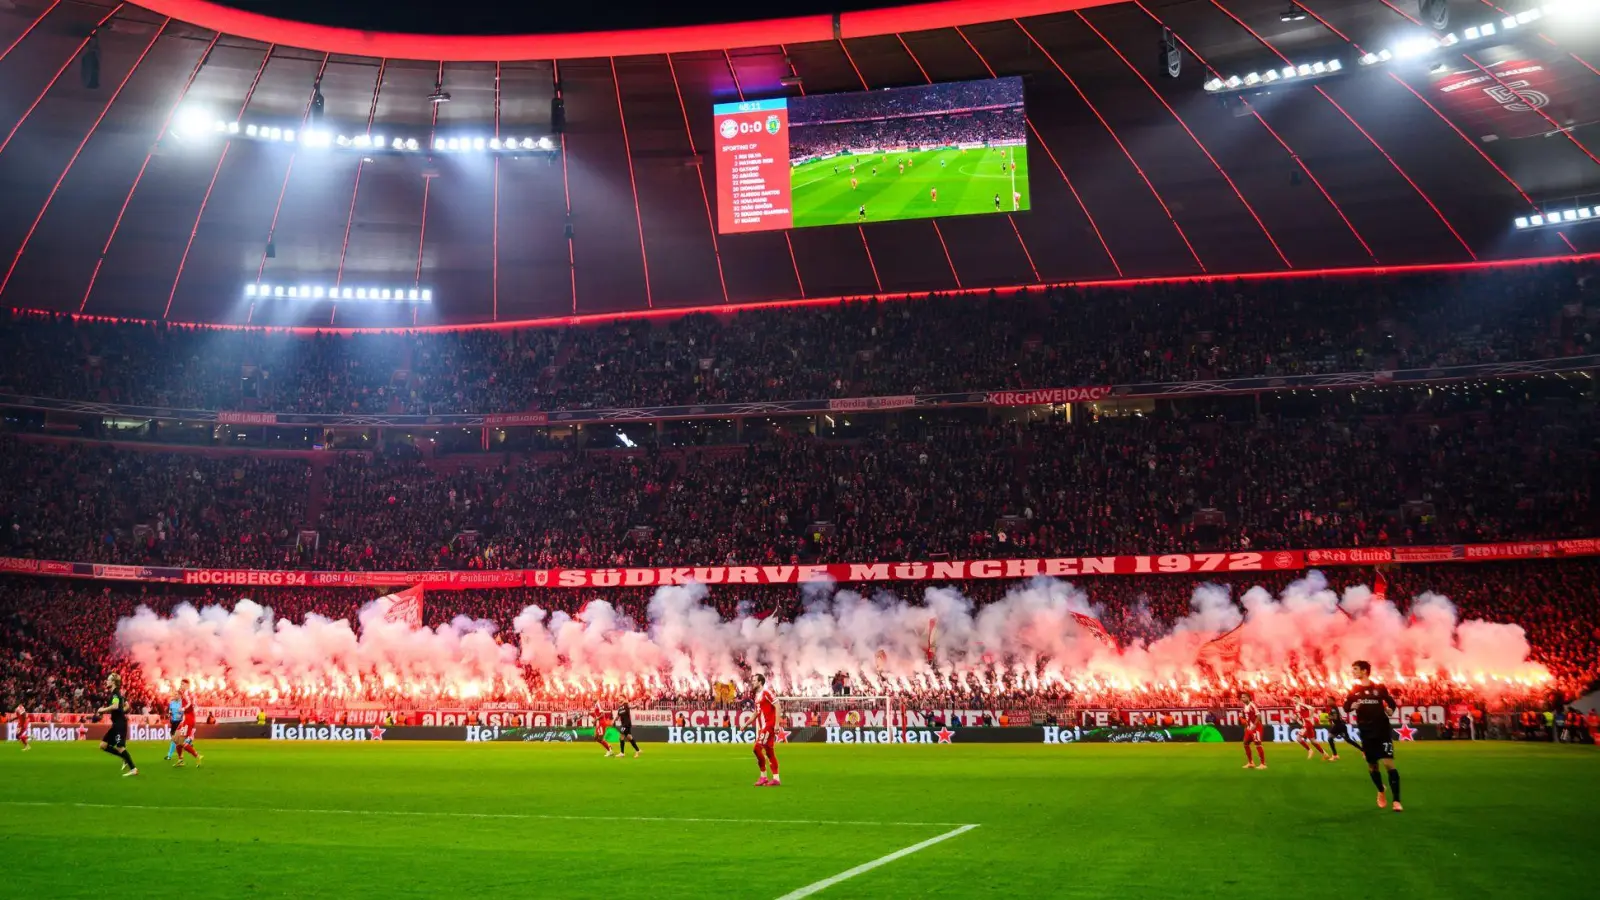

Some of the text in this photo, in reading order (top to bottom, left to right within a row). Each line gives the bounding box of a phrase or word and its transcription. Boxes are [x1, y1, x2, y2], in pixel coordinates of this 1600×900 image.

[1483, 79, 1549, 112] 5
[740, 120, 762, 133] 0:0
[186, 569, 282, 585] HÖCHBERG
[559, 552, 1263, 587] SÜDKURVE MÜNCHEN 1972
[7, 722, 75, 741] Hineken
[130, 722, 178, 741] Heinek
[270, 723, 367, 741] Heineken
[465, 725, 499, 742] Hei
[668, 726, 758, 744] Heineke
[1043, 725, 1081, 744] Hei
